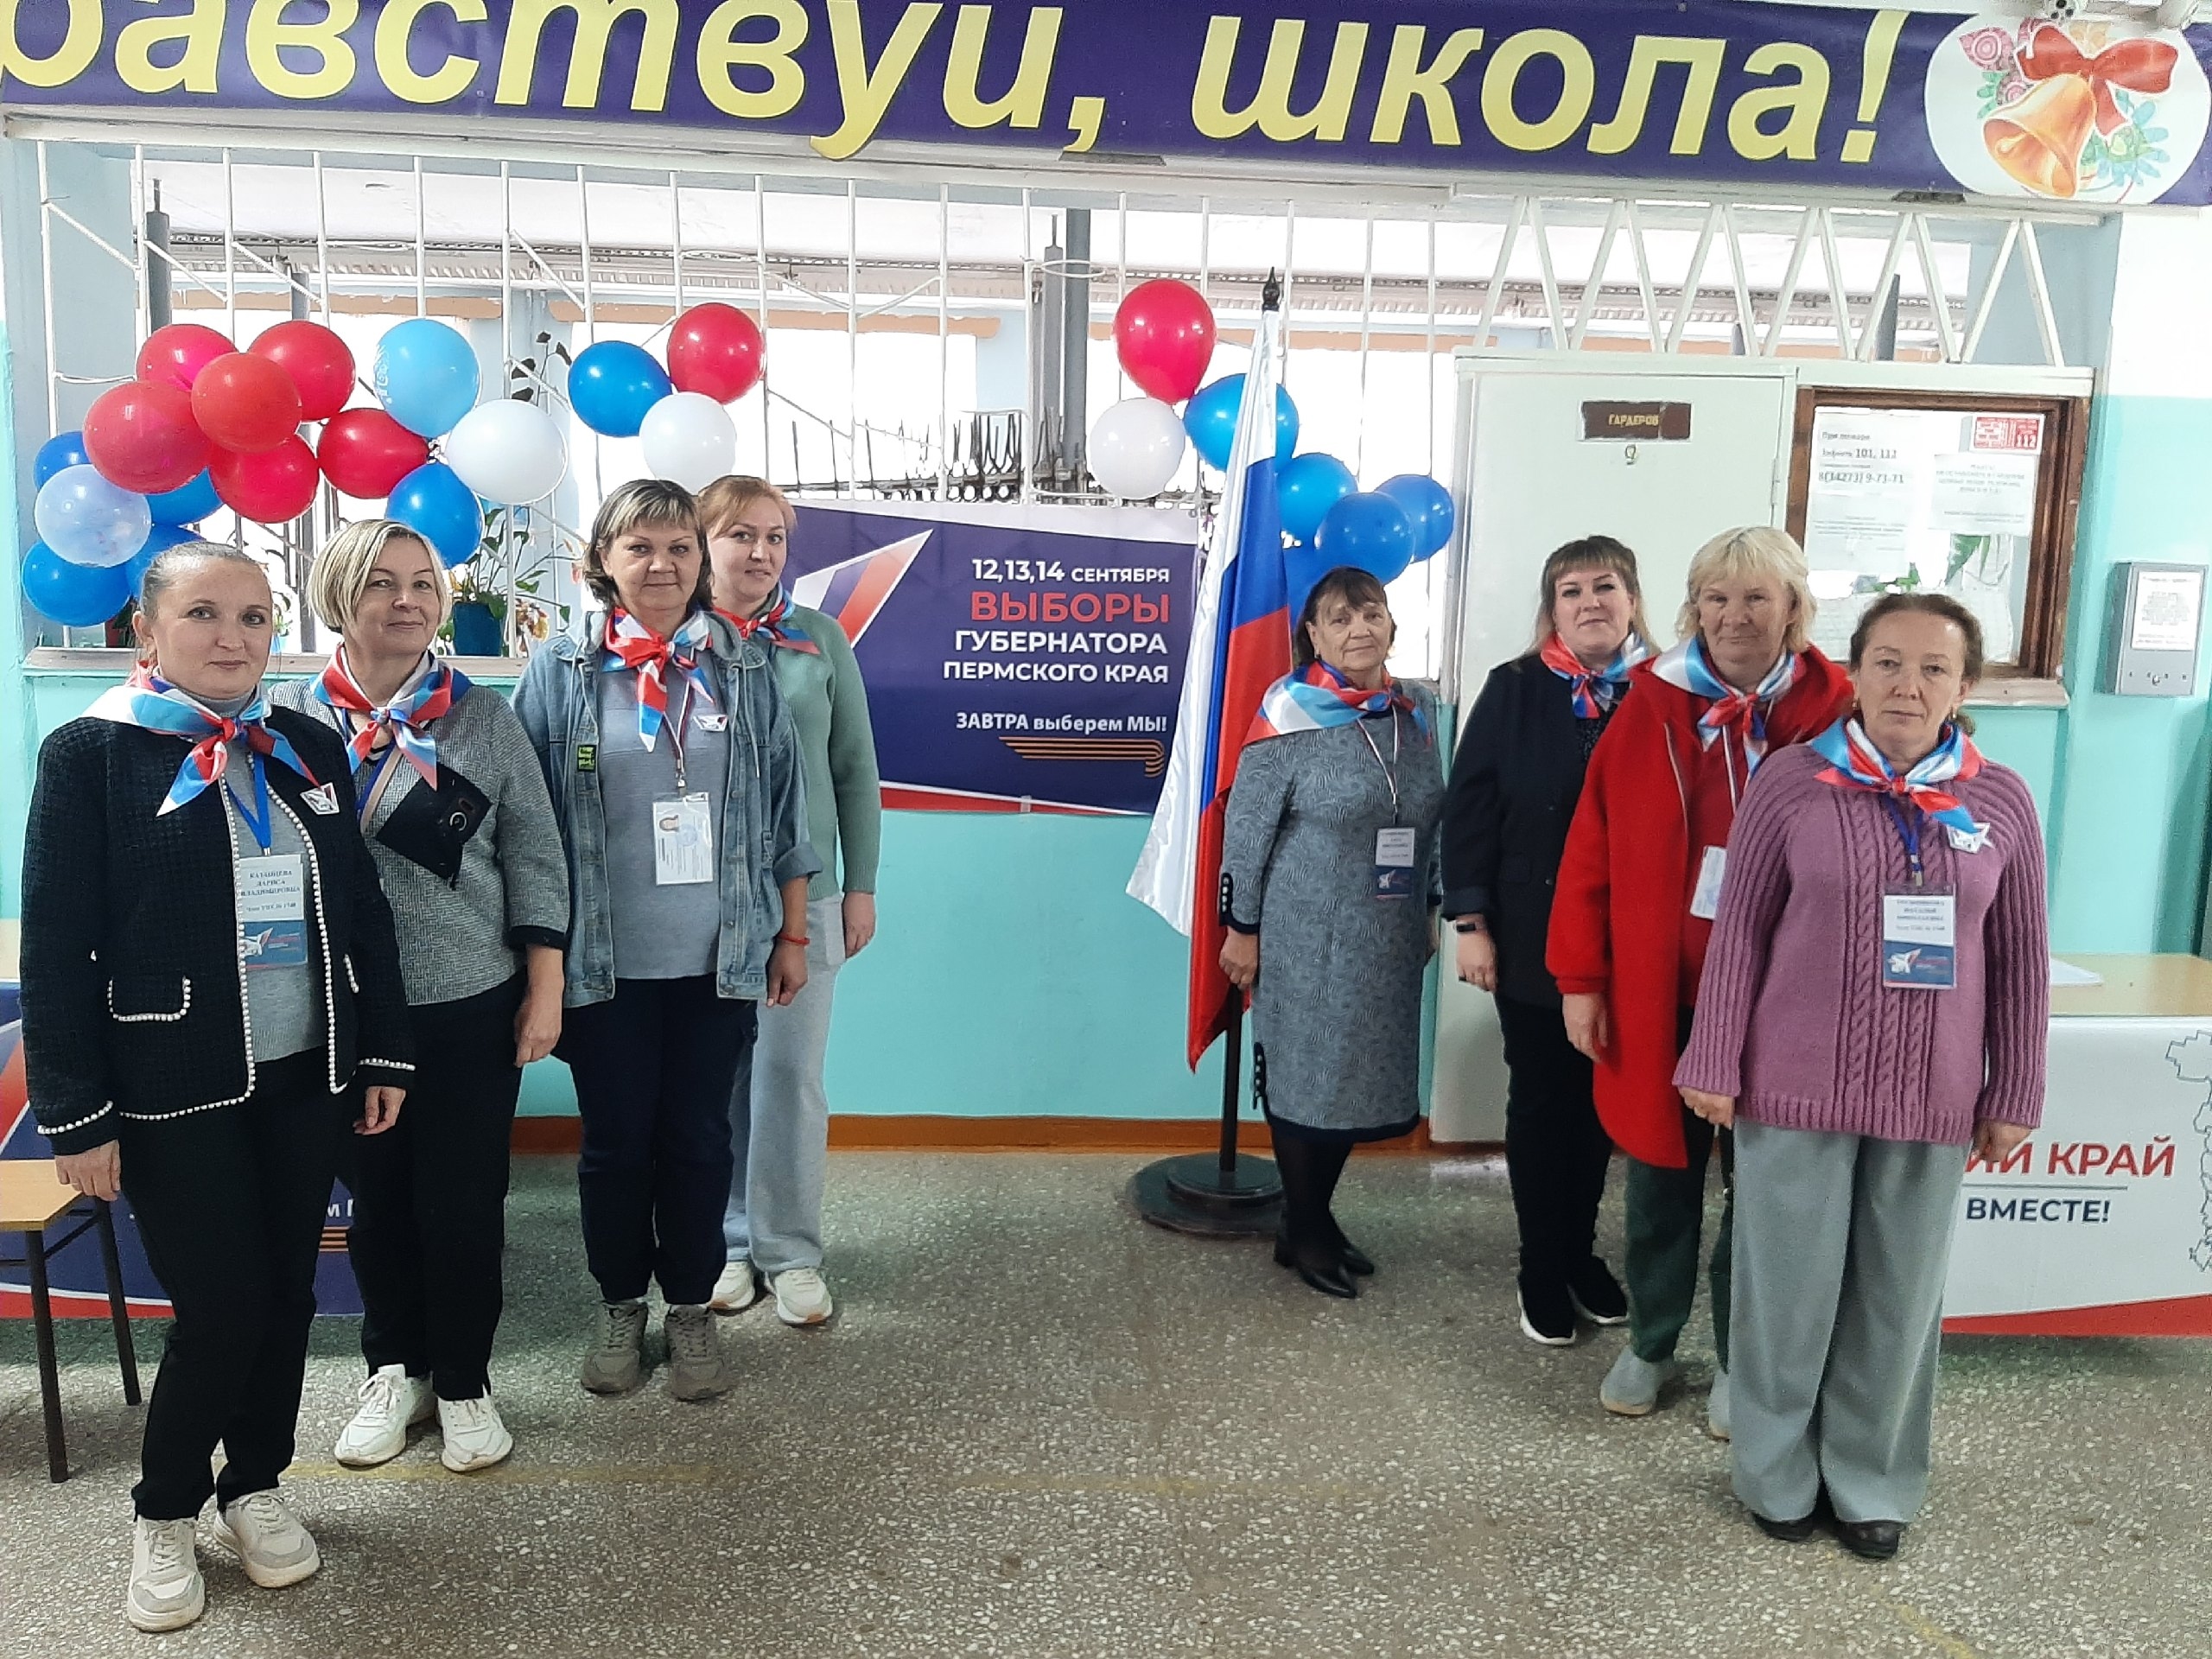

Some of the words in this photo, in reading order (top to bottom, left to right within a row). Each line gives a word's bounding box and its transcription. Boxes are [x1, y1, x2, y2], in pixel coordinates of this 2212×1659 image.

[1192, 10, 1910, 163] школа!
[972, 559, 1065, 583] 12,13,14
[1071, 569, 1170, 582] СЕНТЯБРЯ
[971, 591, 1170, 623] ВЫБОРЫ
[955, 631, 1168, 654] ГУБЕРНАТОРА
[944, 662, 1097, 681] ПЕРМСКОГО
[1105, 664, 1168, 683] КРАЯ
[956, 713, 1028, 730] ЗАВТРА
[1033, 715, 1122, 734] выберем
[1127, 716, 1167, 732] МЫ!
[2048, 1135, 2176, 1177] КРАЙ
[1967, 1198, 2110, 1223] ВМЕСТЕ!
